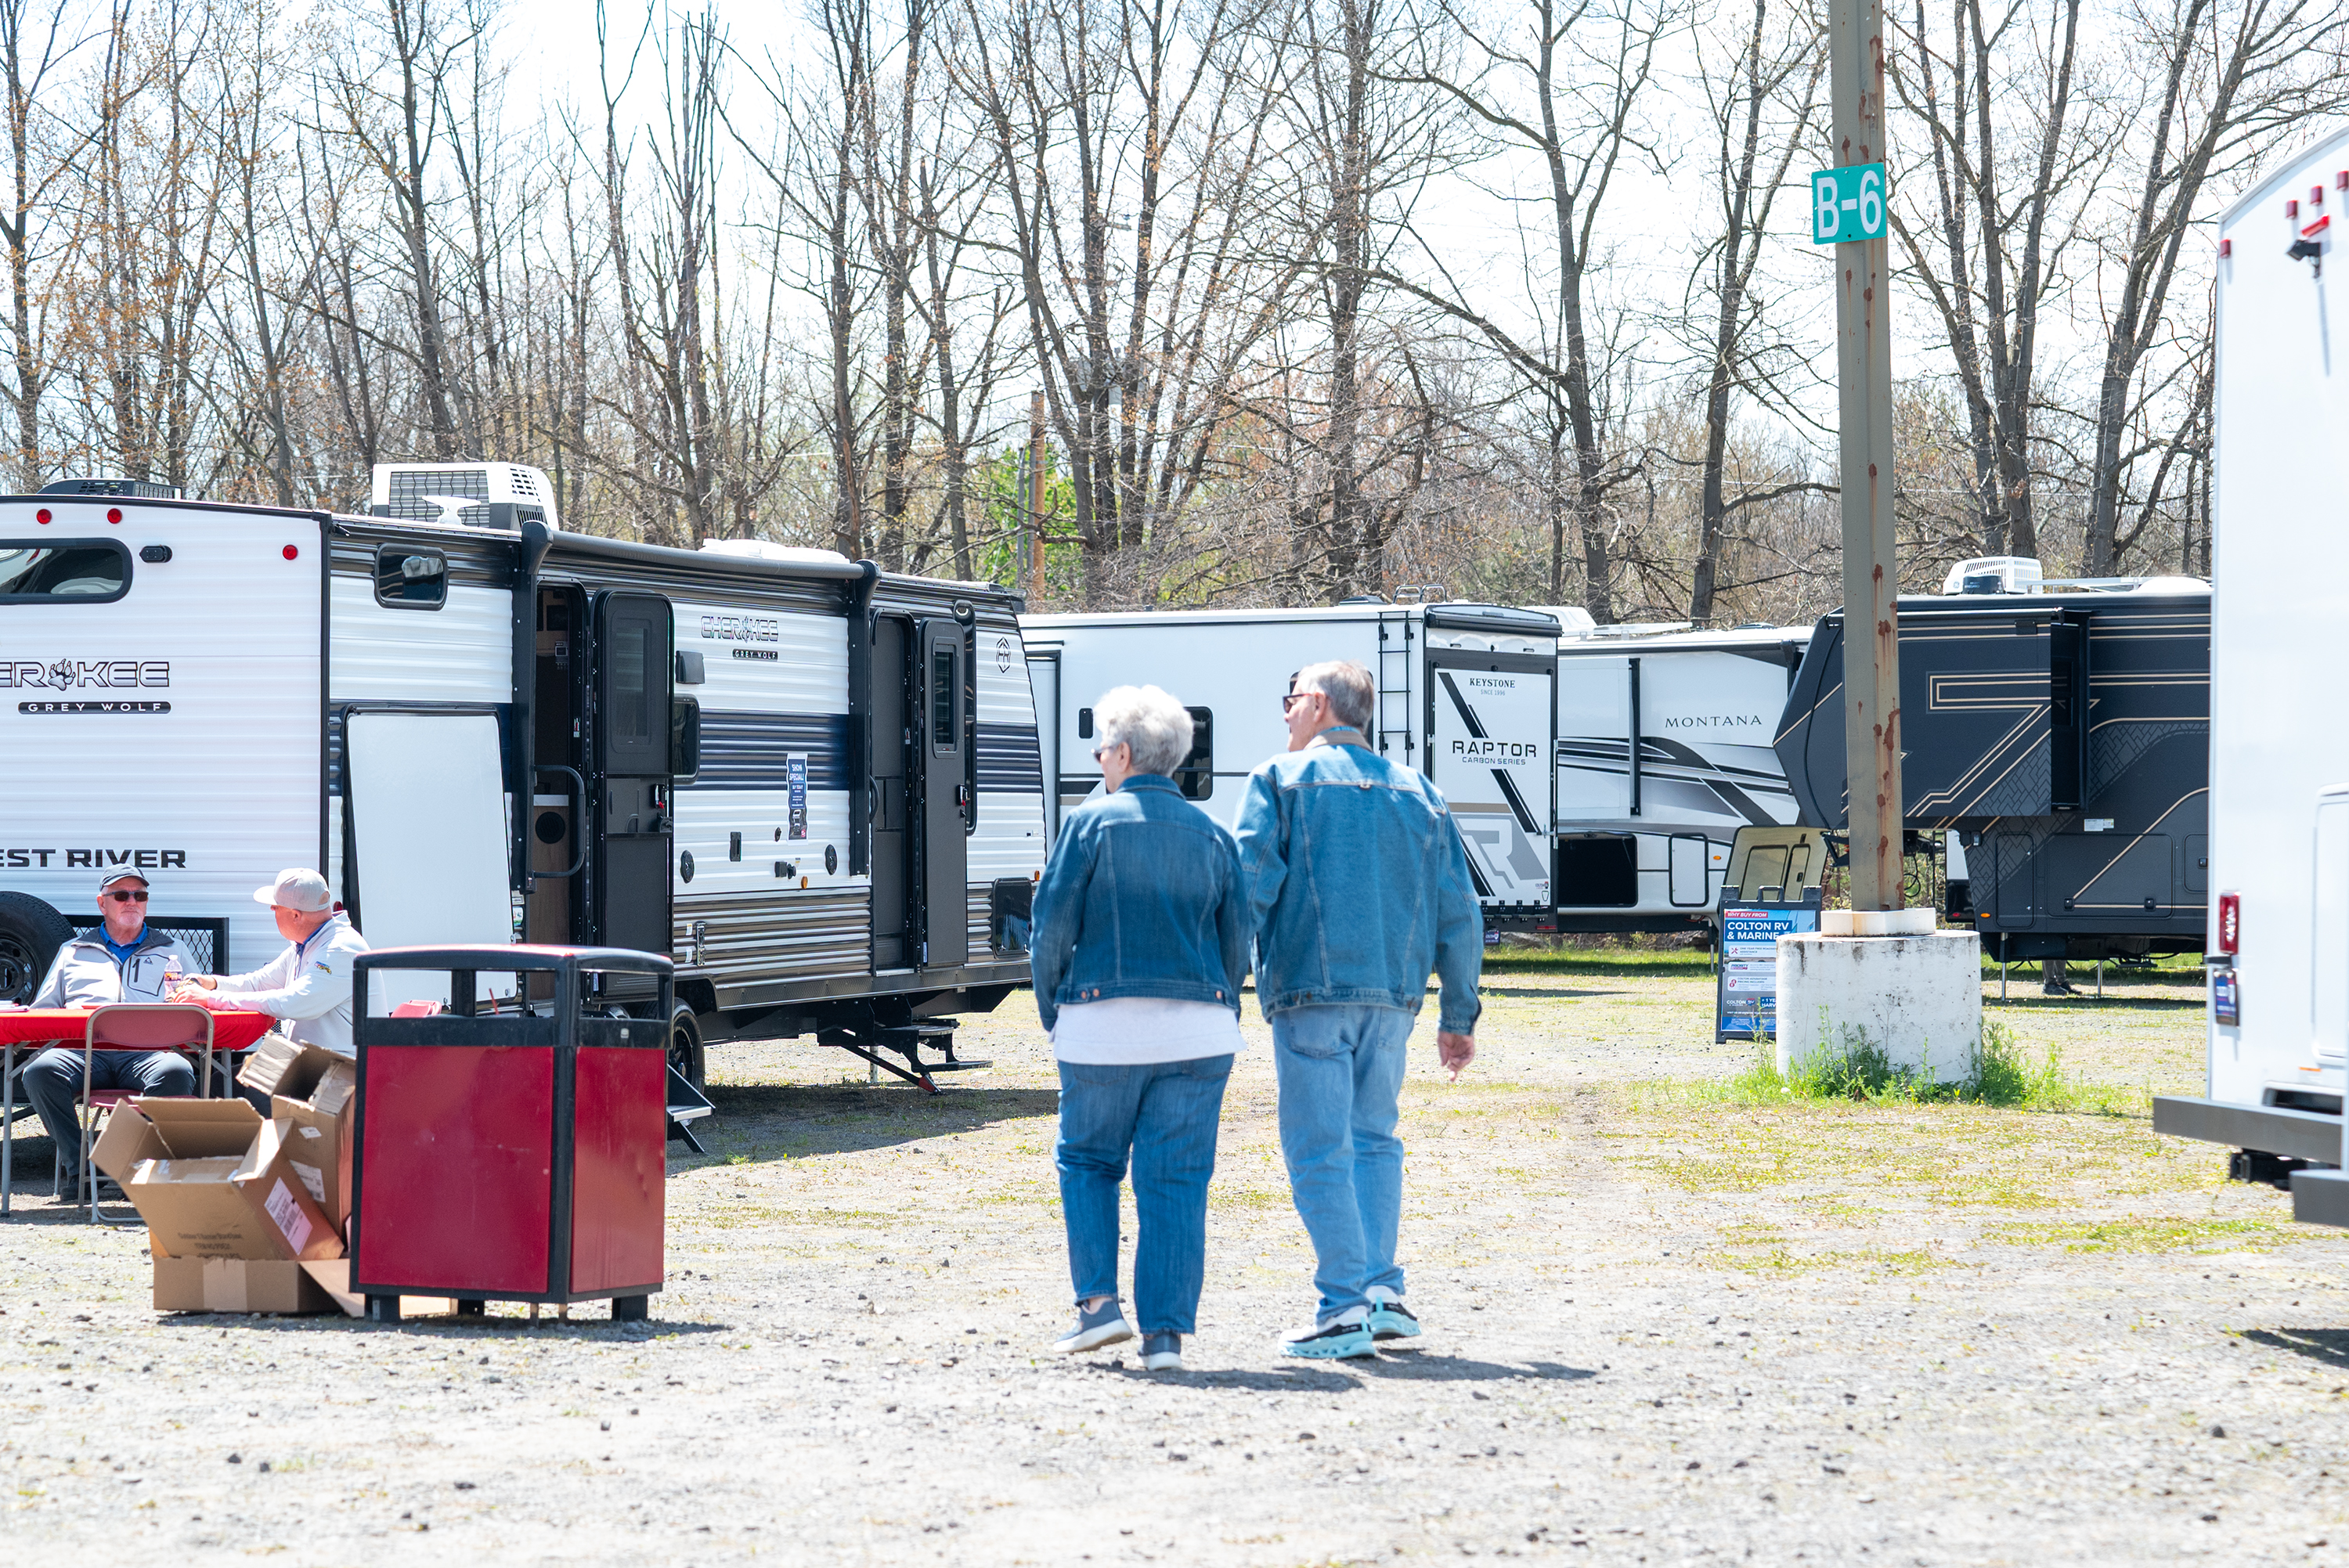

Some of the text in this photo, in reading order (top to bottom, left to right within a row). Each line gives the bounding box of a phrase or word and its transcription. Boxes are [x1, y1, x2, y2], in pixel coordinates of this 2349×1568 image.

[1817, 170, 1882, 238] B-6
[1469, 678, 1516, 688] KEYSTONE
[27, 702, 162, 712] GREY WOLF
[1665, 715, 1763, 729] MONTANA
[1452, 740, 1537, 758] RAPTOR
[0, 849, 186, 868] ST RIVER
[1727, 921, 1771, 931] COLTON
[1737, 932, 1780, 940] MARINE
